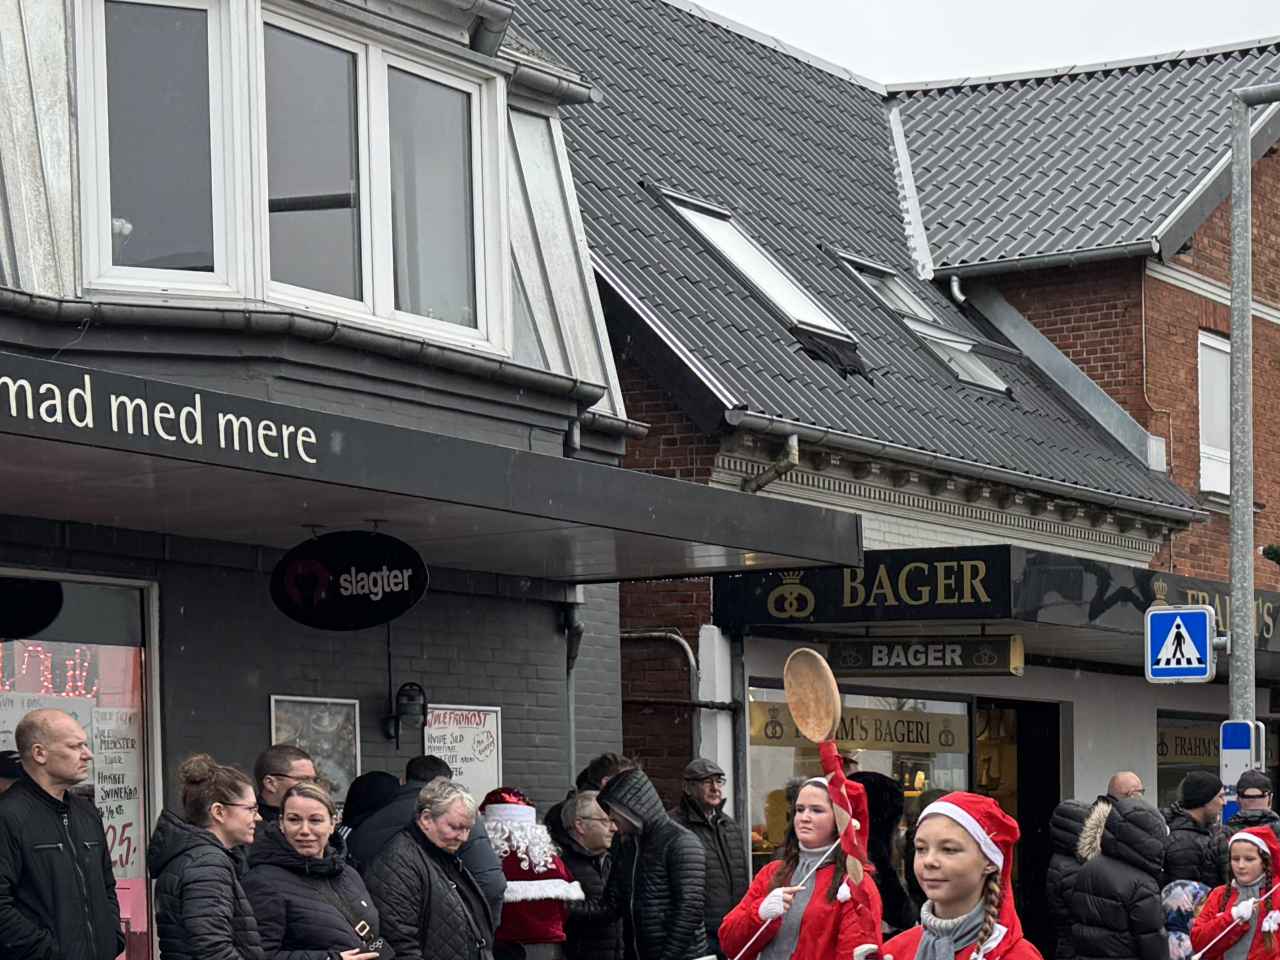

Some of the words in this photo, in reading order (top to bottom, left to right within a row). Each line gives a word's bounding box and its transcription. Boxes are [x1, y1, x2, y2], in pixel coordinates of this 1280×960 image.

[110, 393, 203, 445] med
[218, 412, 317, 464] mere
[340, 565, 413, 601] slagter
[842, 560, 991, 607] BAGER
[871, 644, 963, 666] BAGER
[874, 720, 931, 745] BAGERI
